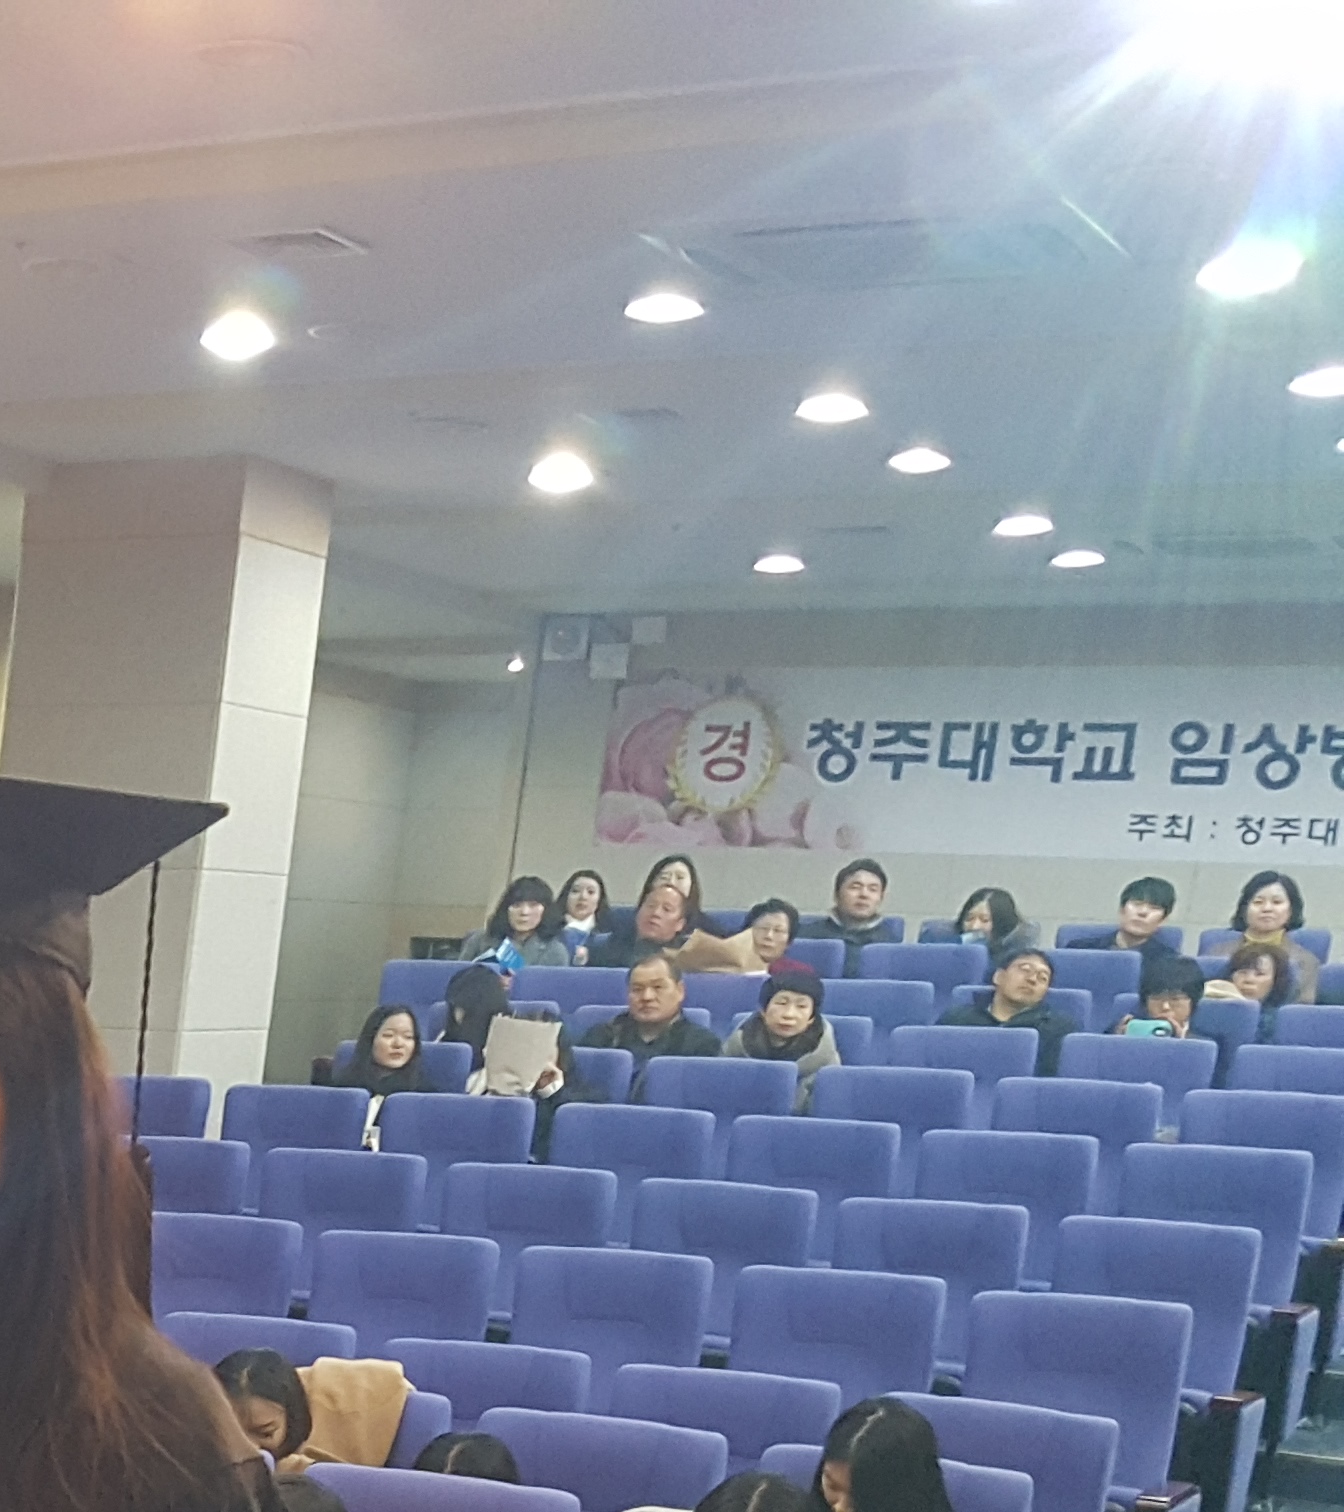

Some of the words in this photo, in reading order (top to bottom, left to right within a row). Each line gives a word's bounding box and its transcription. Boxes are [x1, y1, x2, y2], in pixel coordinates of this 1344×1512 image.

[698, 720, 752, 783] 경
[805, 718, 1137, 784] 청주대학교
[1127, 813, 1195, 844] 주최
[1234, 814, 1340, 846] 청주대
